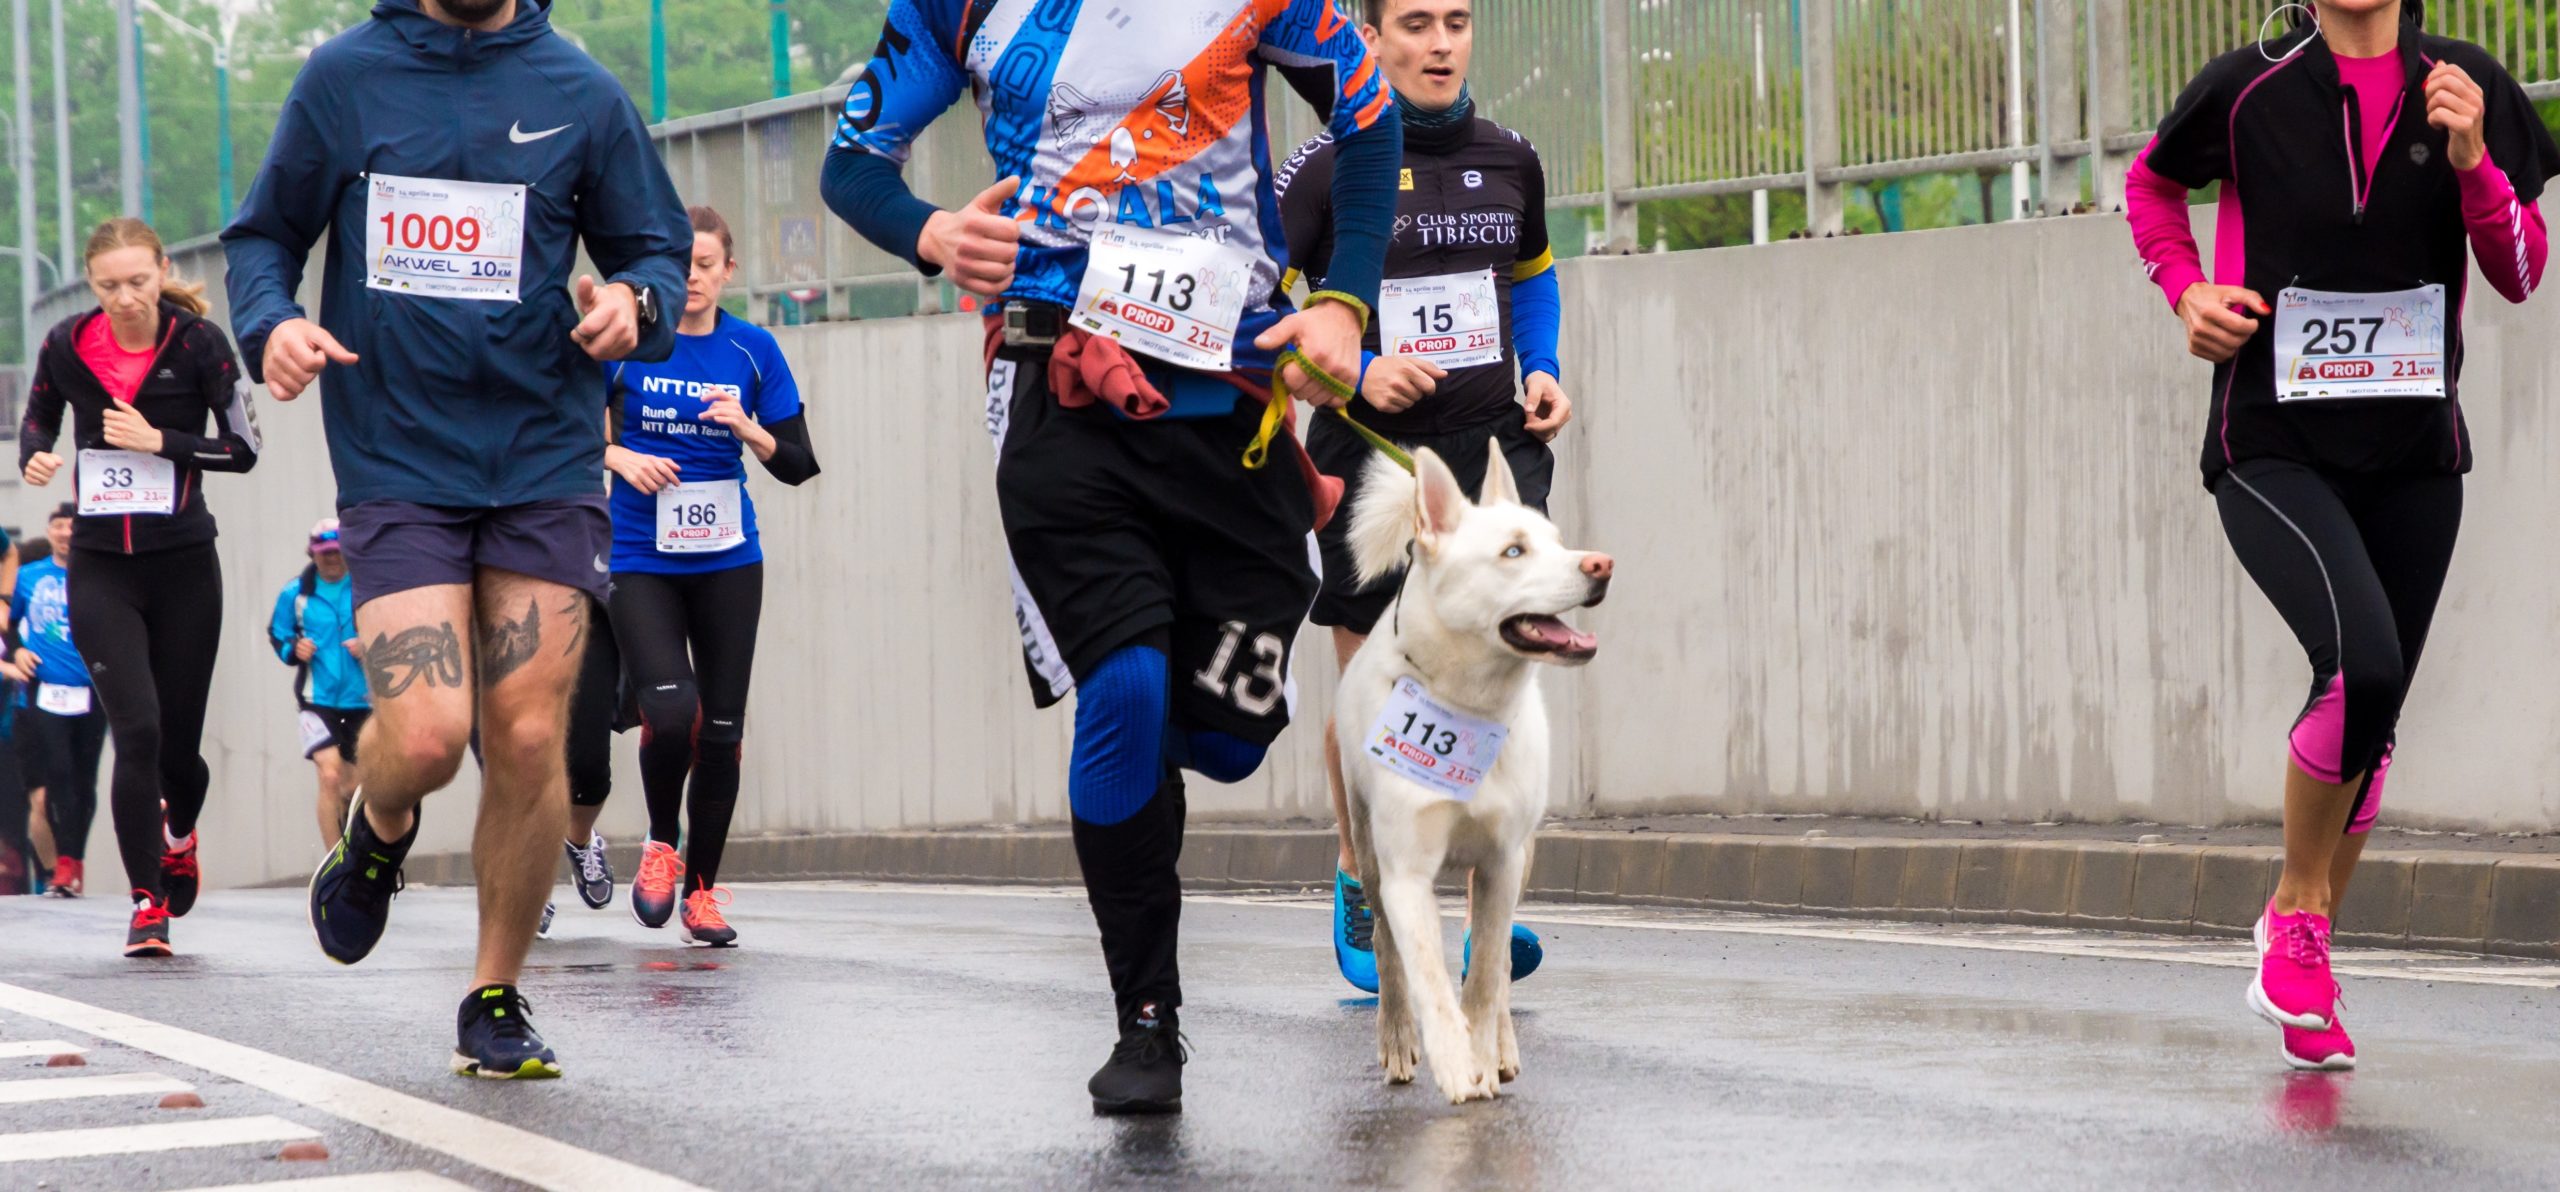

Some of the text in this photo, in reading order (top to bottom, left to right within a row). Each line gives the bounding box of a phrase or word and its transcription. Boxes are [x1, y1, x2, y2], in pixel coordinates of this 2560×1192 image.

[1031, 173, 1225, 231] KOALA
[1416, 212, 1514, 226] CLUB SPORTIV
[380, 211, 480, 253] 1009
[1417, 225, 1516, 245] TIBISCUS
[384, 254, 459, 273] AKWEL
[1118, 263, 1196, 311] 113
[1125, 305, 1171, 331] PROFI
[1412, 303, 1453, 334] 15
[1418, 338, 1453, 351] PROFI
[2301, 317, 2385, 355] 257
[2324, 363, 2369, 377] PROFI
[643, 376, 685, 395] NTT
[642, 405, 677, 419] Run@
[642, 420, 729, 437] NTT DATA Team
[102, 467, 133, 488] 33
[672, 503, 716, 525] 186
[682, 529, 709, 537] PROFI
[1194, 620, 1284, 716] 13
[1401, 711, 1457, 756] 113
[1401, 745, 1433, 766] PROFI
